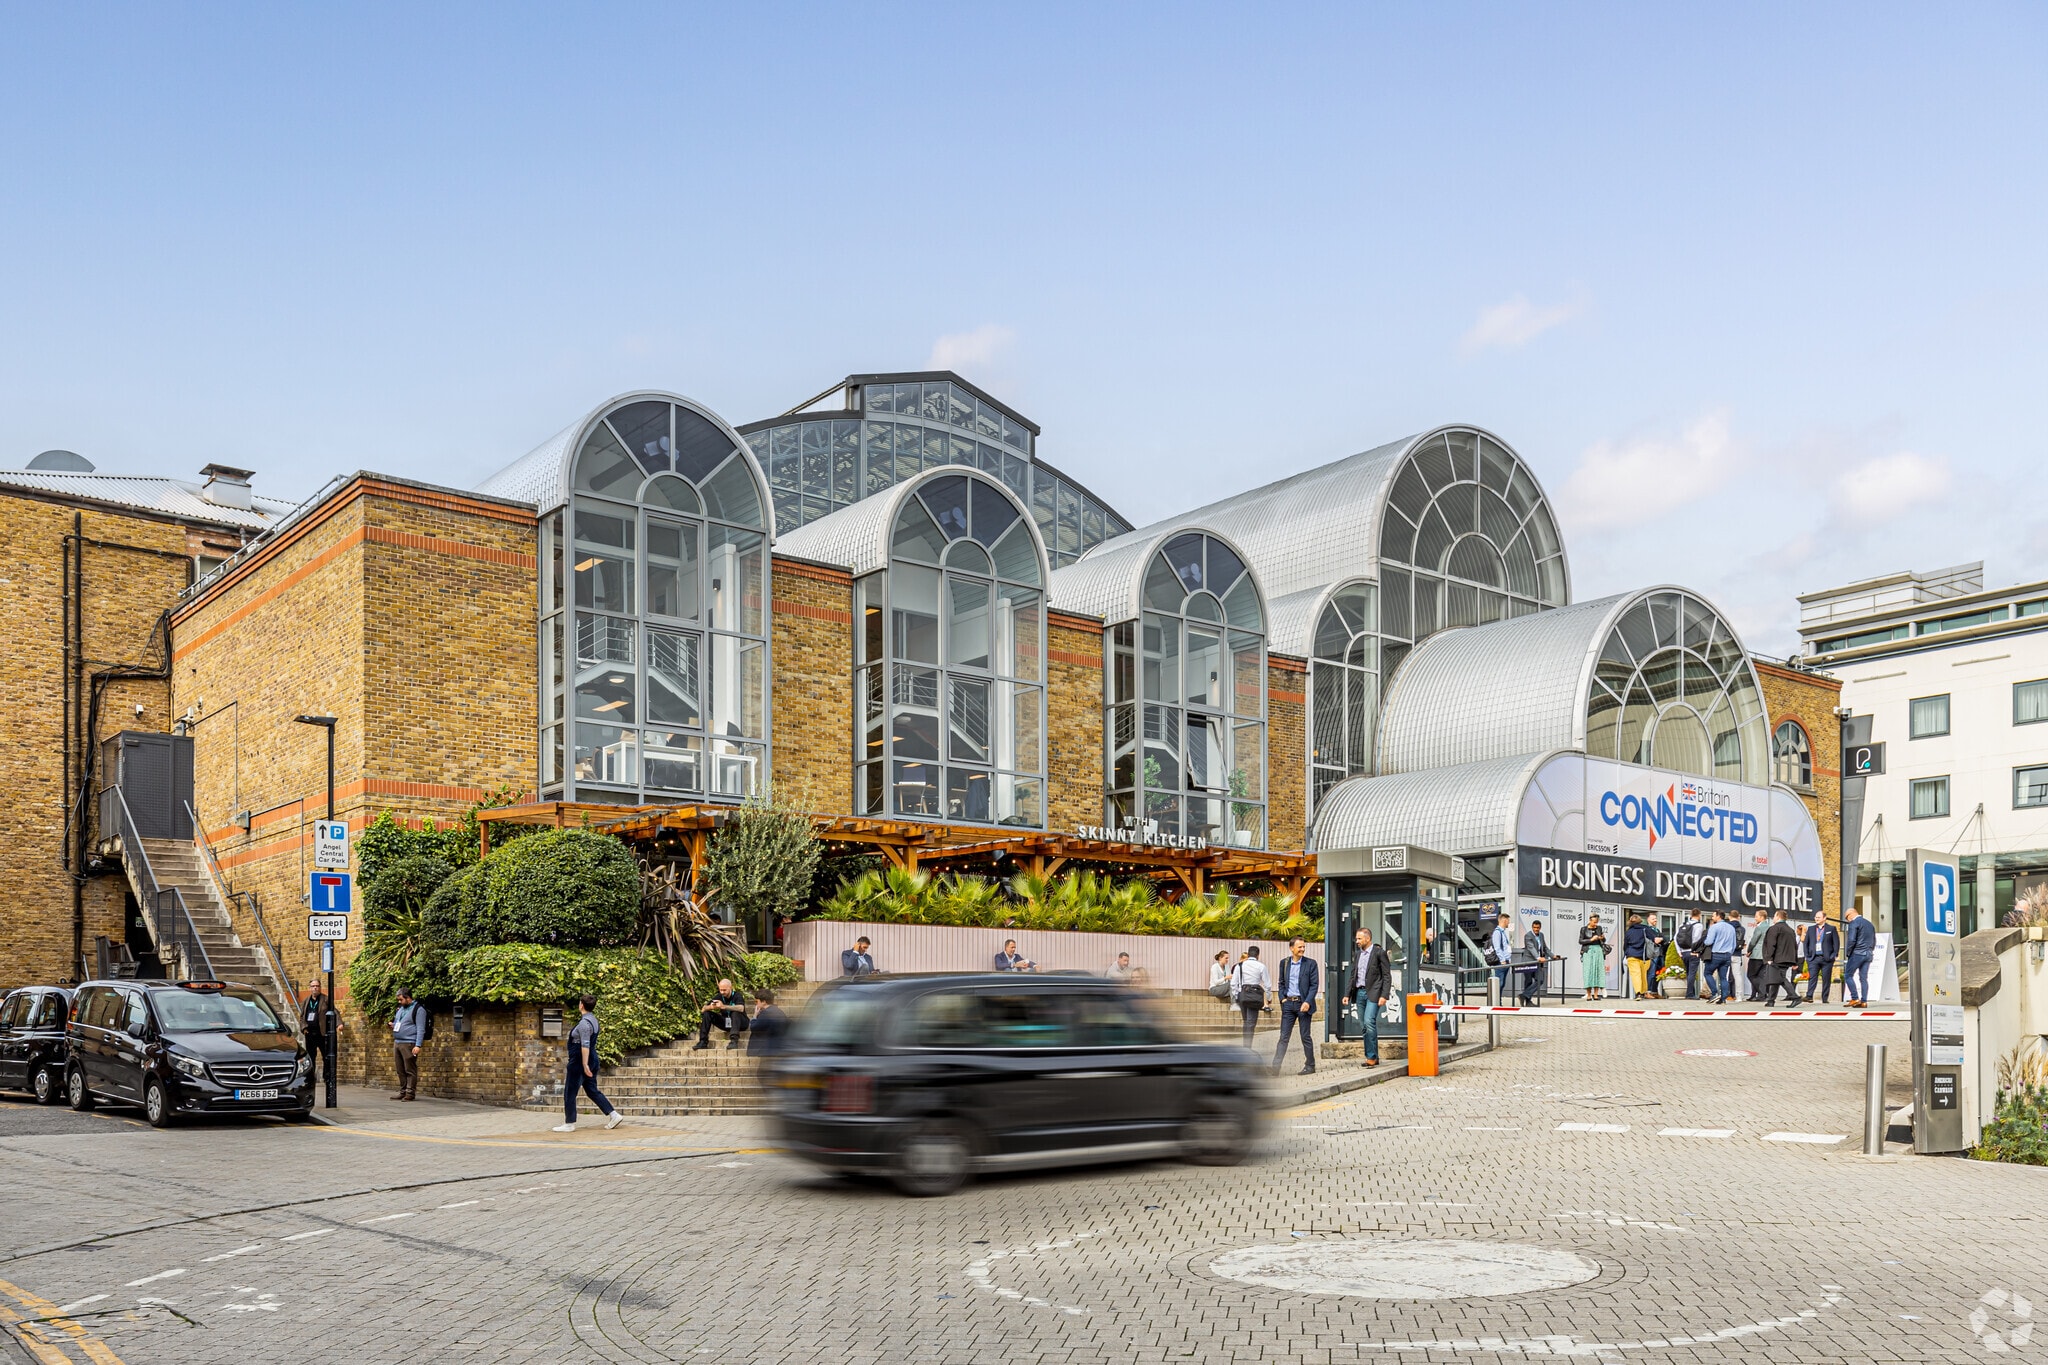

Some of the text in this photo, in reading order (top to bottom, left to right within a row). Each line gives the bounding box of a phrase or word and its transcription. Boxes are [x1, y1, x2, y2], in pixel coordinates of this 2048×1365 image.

[1697, 786, 1731, 807] Britain
[1600, 791, 1758, 845] CONNECTED
[333, 827, 342, 838] P
[1078, 826, 1206, 849] SKINNY KITCHEN
[1587, 843, 1611, 852] ERICSSON
[1376, 860, 1403, 868] CENTRE
[1756, 856, 1768, 865] total
[1541, 857, 1813, 912] BUSINESS DESIGN CENTRE
[1932, 873, 1950, 923] P
[1520, 907, 1549, 917] CONNECTED
[313, 919, 343, 928] Except
[314, 929, 342, 937] cycles
[240, 1090, 261, 1098] KE66
